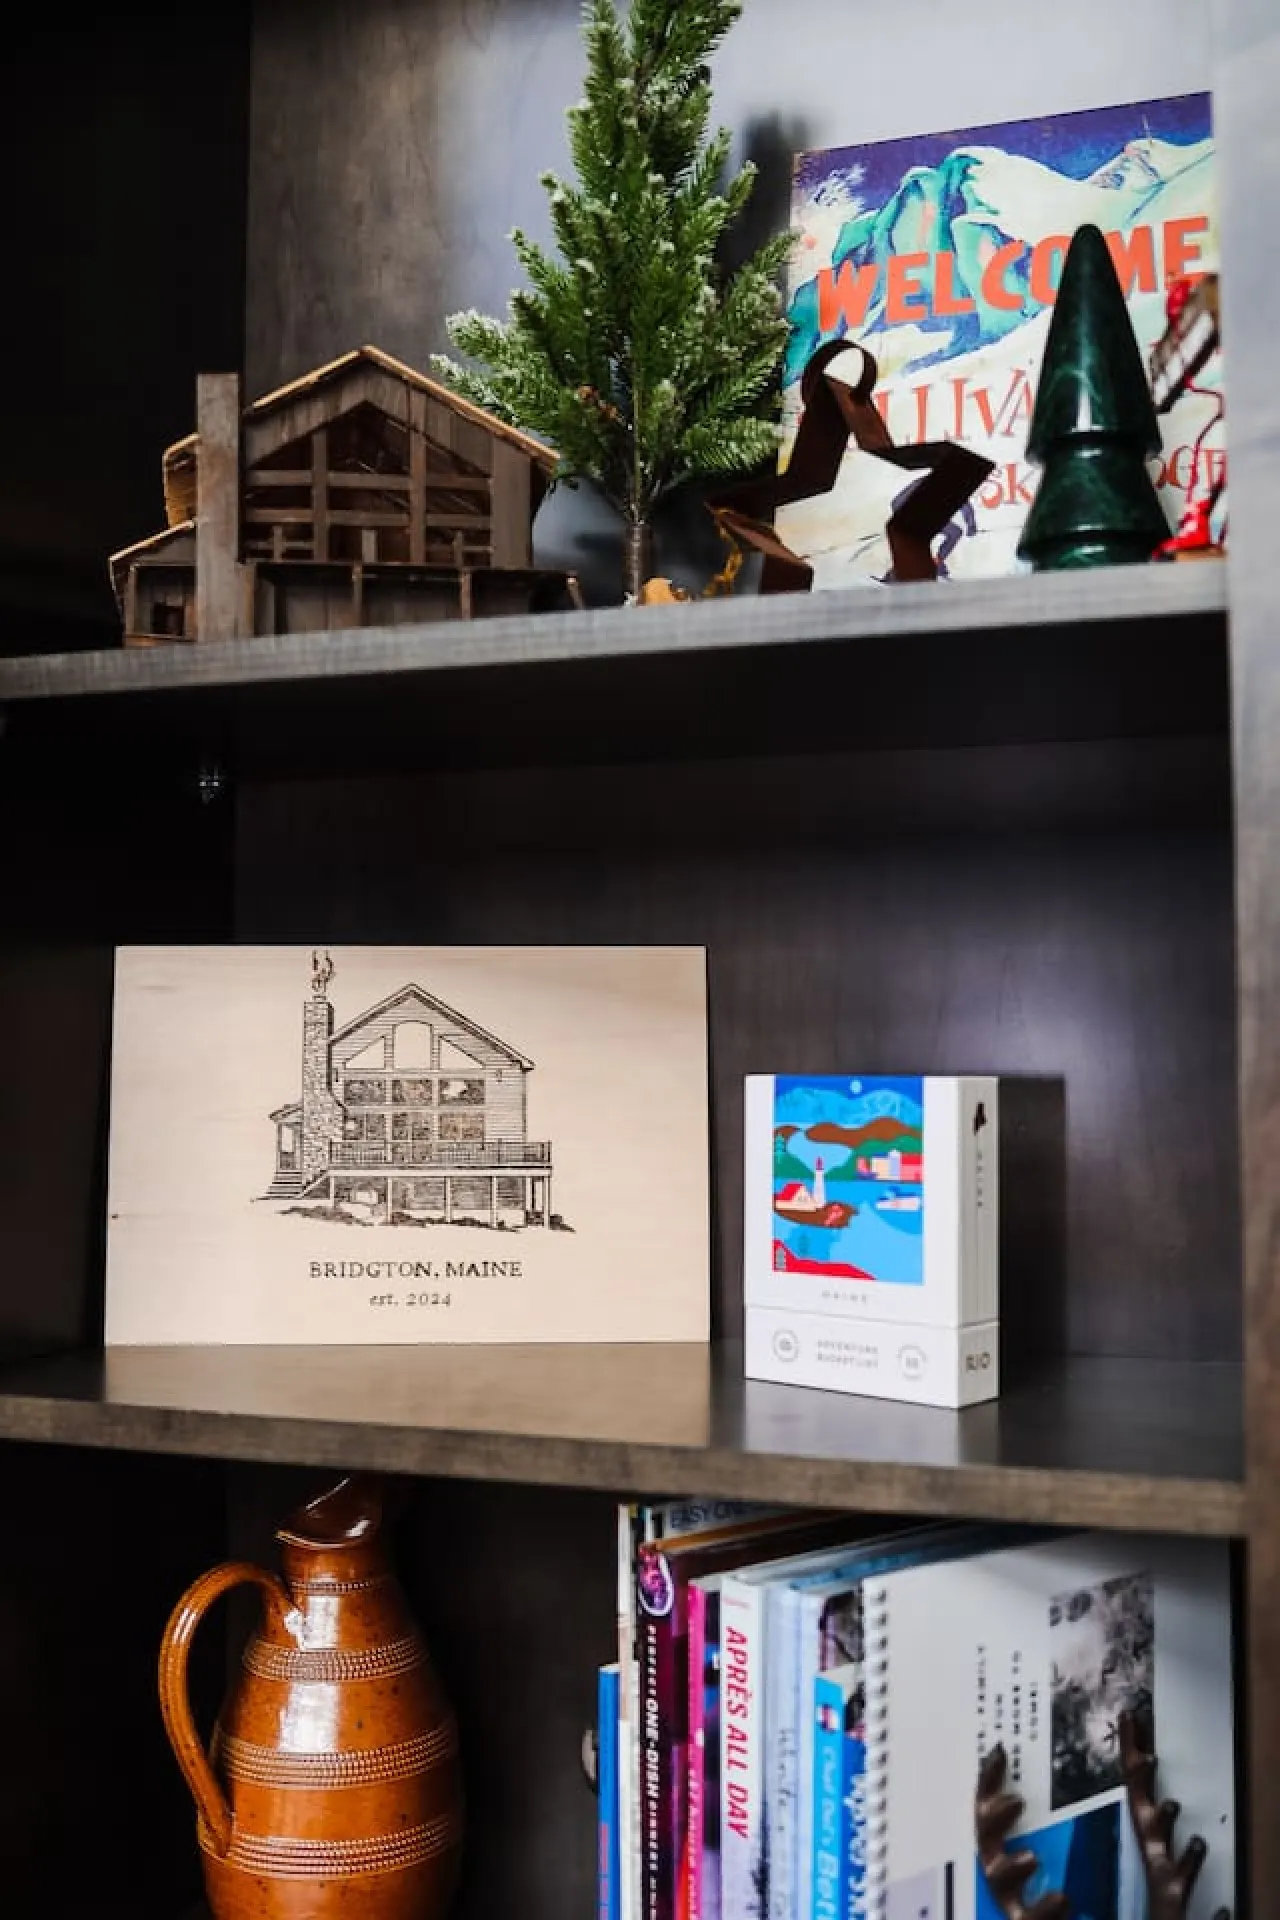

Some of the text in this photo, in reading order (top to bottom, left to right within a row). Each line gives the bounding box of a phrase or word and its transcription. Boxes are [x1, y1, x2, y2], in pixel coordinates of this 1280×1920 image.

[817, 216, 1211, 333] WELCOME
[308, 1260, 523, 1280] BRIDGTON, MAINE
[369, 1292, 452, 1307] est. 2024
[726, 1723, 749, 1771] ALL
[726, 1781, 749, 1840] DAY
